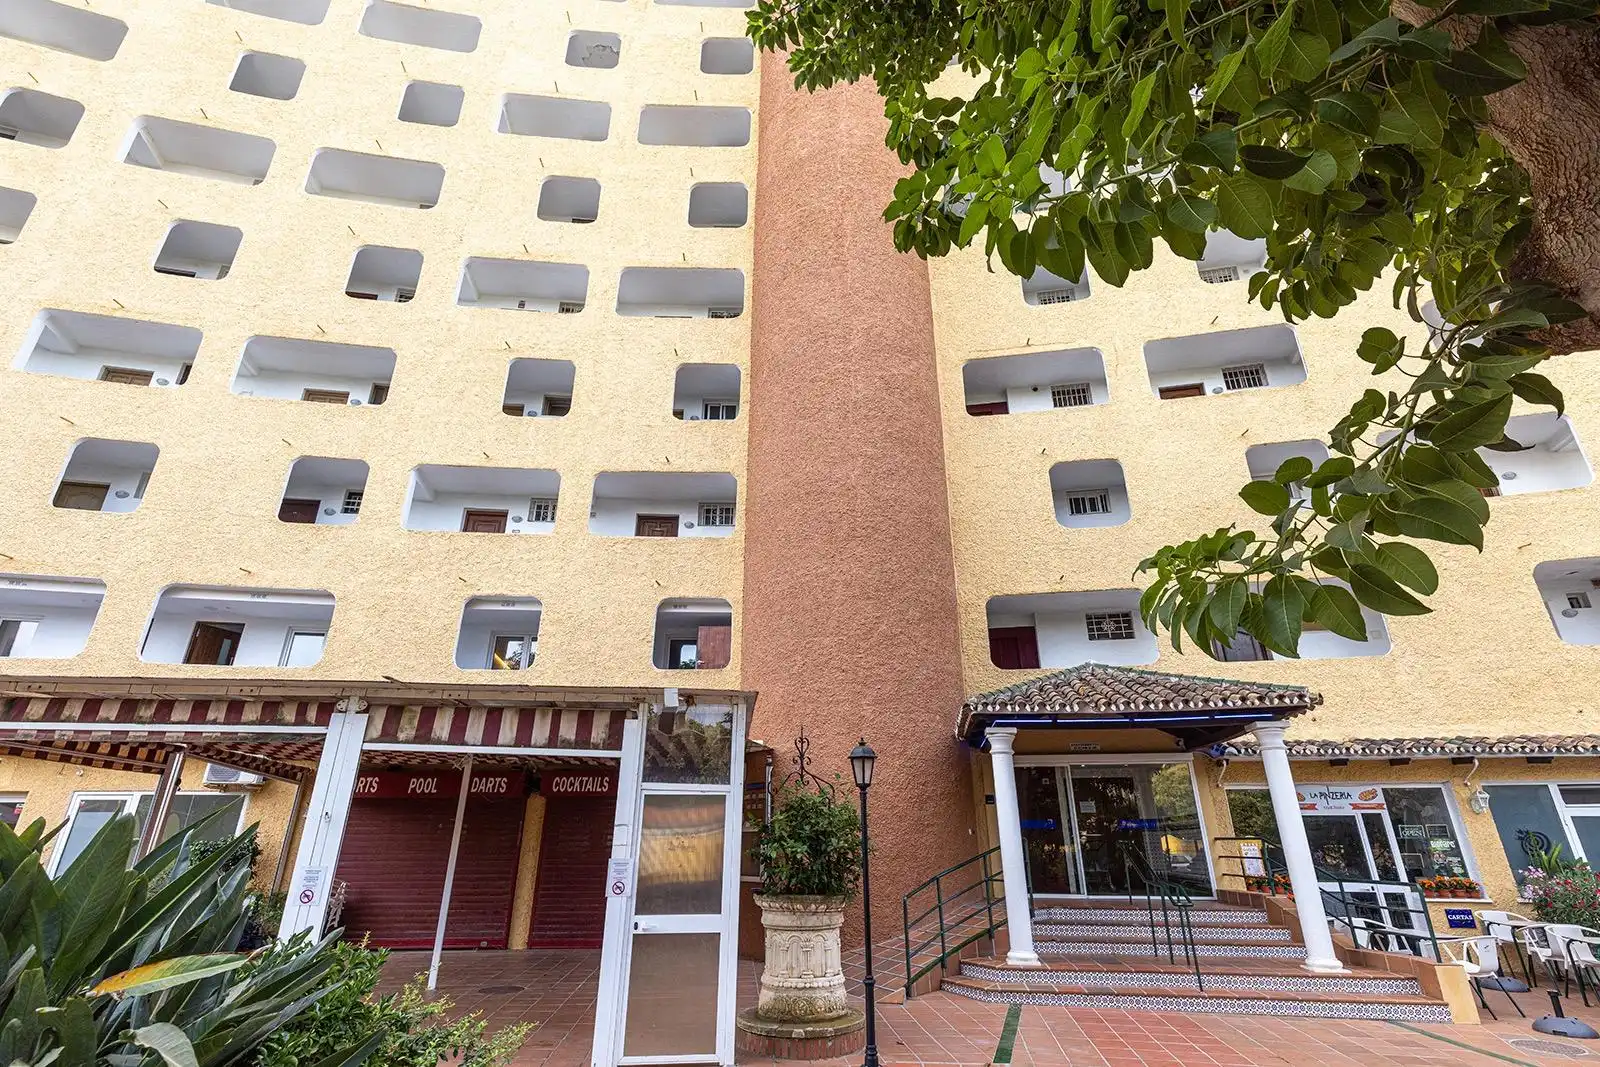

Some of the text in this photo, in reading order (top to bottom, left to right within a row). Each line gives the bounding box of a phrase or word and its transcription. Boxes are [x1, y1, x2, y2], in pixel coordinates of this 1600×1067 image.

[355, 776, 610, 794] RTS POOL DARTS COCKTAILS
